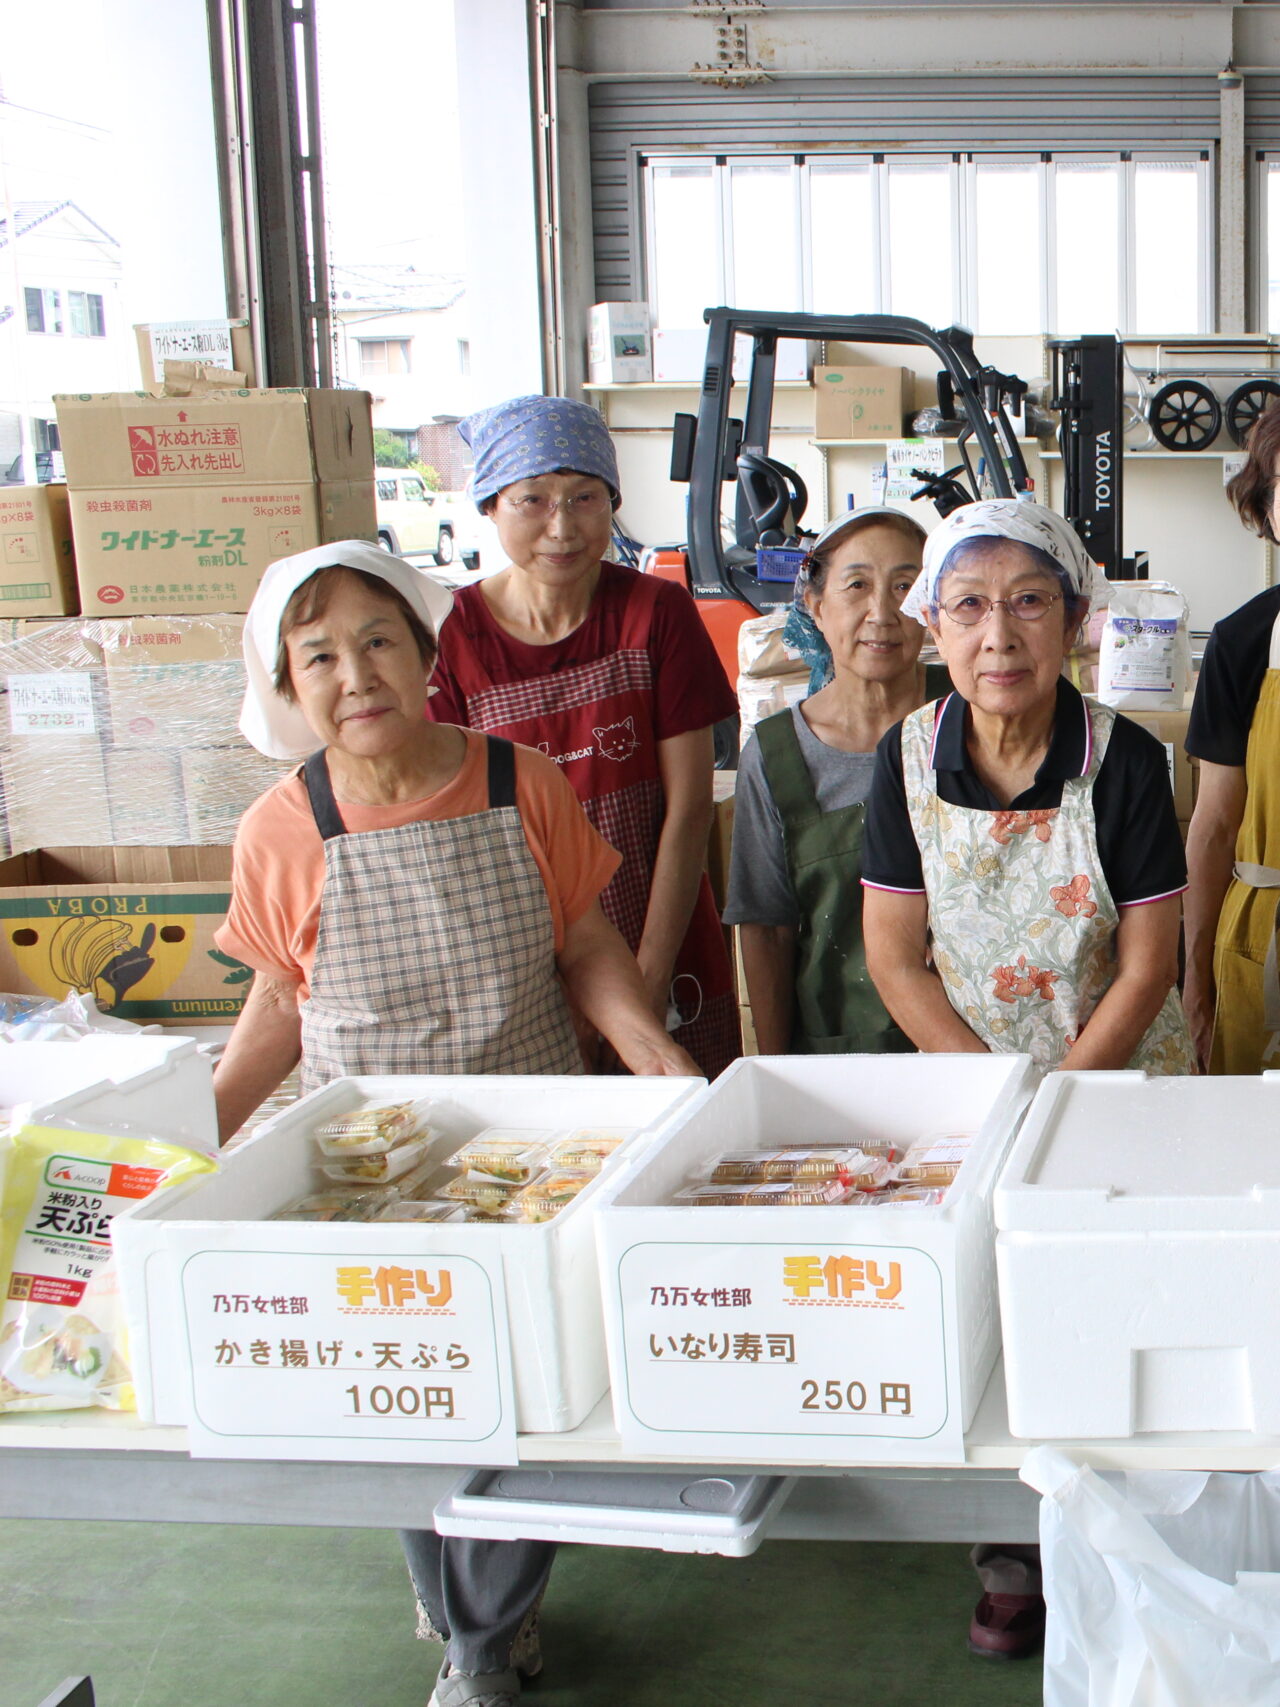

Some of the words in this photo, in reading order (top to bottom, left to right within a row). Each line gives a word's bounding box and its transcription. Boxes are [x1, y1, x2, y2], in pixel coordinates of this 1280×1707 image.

[157, 427, 239, 446] 水ぬれ注意
[160, 452, 242, 472] 先入れ先出し
[1096, 431, 1111, 511] TOYOTA
[86, 500, 153, 513] 殺虫殺菌剤
[101, 528, 247, 552] ワイドナーエース
[198, 550, 248, 567] 粉剤DL
[48, 897, 147, 914] PROBA
[48, 1192, 102, 1210] 米粉入り
[67, 1264, 93, 1278] 1kg
[783, 1255, 901, 1300] 手作り
[336, 1266, 453, 1307] 手作り
[213, 1295, 309, 1315] 乃万女性部
[650, 1287, 752, 1307] 乃万女性部
[214, 1339, 470, 1369] かき揚げ・天ぷら
[650, 1332, 795, 1362] いなり寿司
[346, 1385, 455, 1417] 100円
